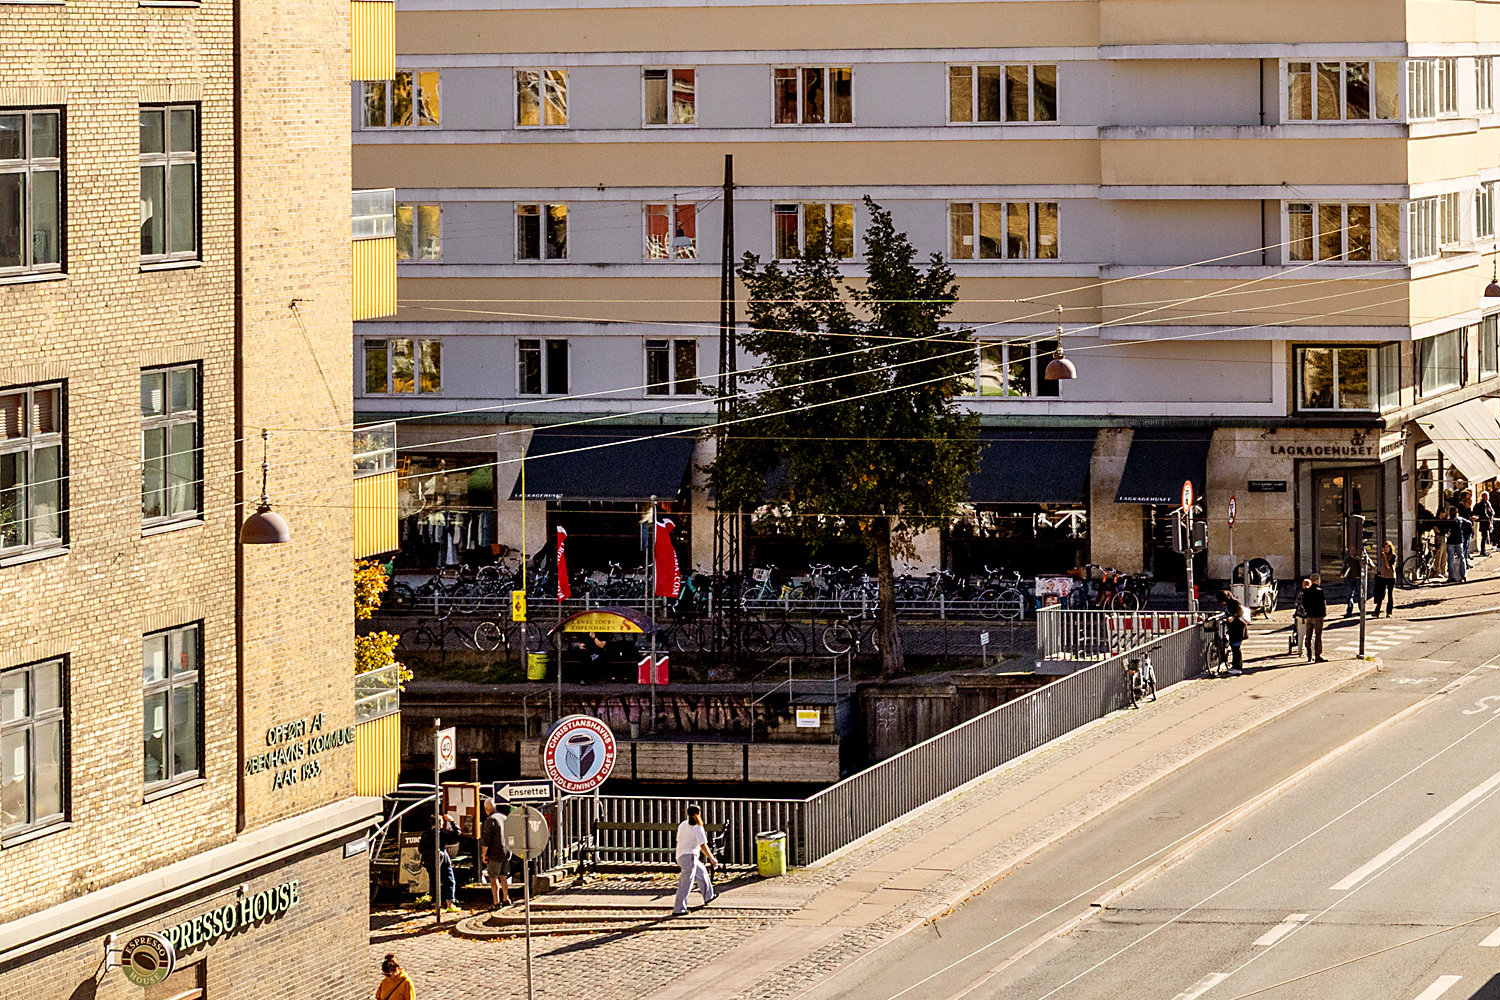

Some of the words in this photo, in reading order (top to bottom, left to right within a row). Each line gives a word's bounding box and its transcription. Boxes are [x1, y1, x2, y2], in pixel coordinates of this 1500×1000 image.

[1270, 446, 1373, 455] LAGKAGEHUSET
[549, 720, 611, 749] CHRISTIANSHAVNS
[245, 742, 305, 777] ØBENHAVNS
[307, 725, 355, 757] KOMMUNE
[442, 742, 450, 753] 40
[272, 767, 298, 792] AAR
[300, 759, 321, 782] 1933
[508, 788, 548, 796] Ensrettet
[161, 904, 237, 951] SPRESSO
[239, 880, 300, 927] HOUSE
[126, 935, 166, 957] ESPRESSO
[129, 972, 162, 985] HOUSE
